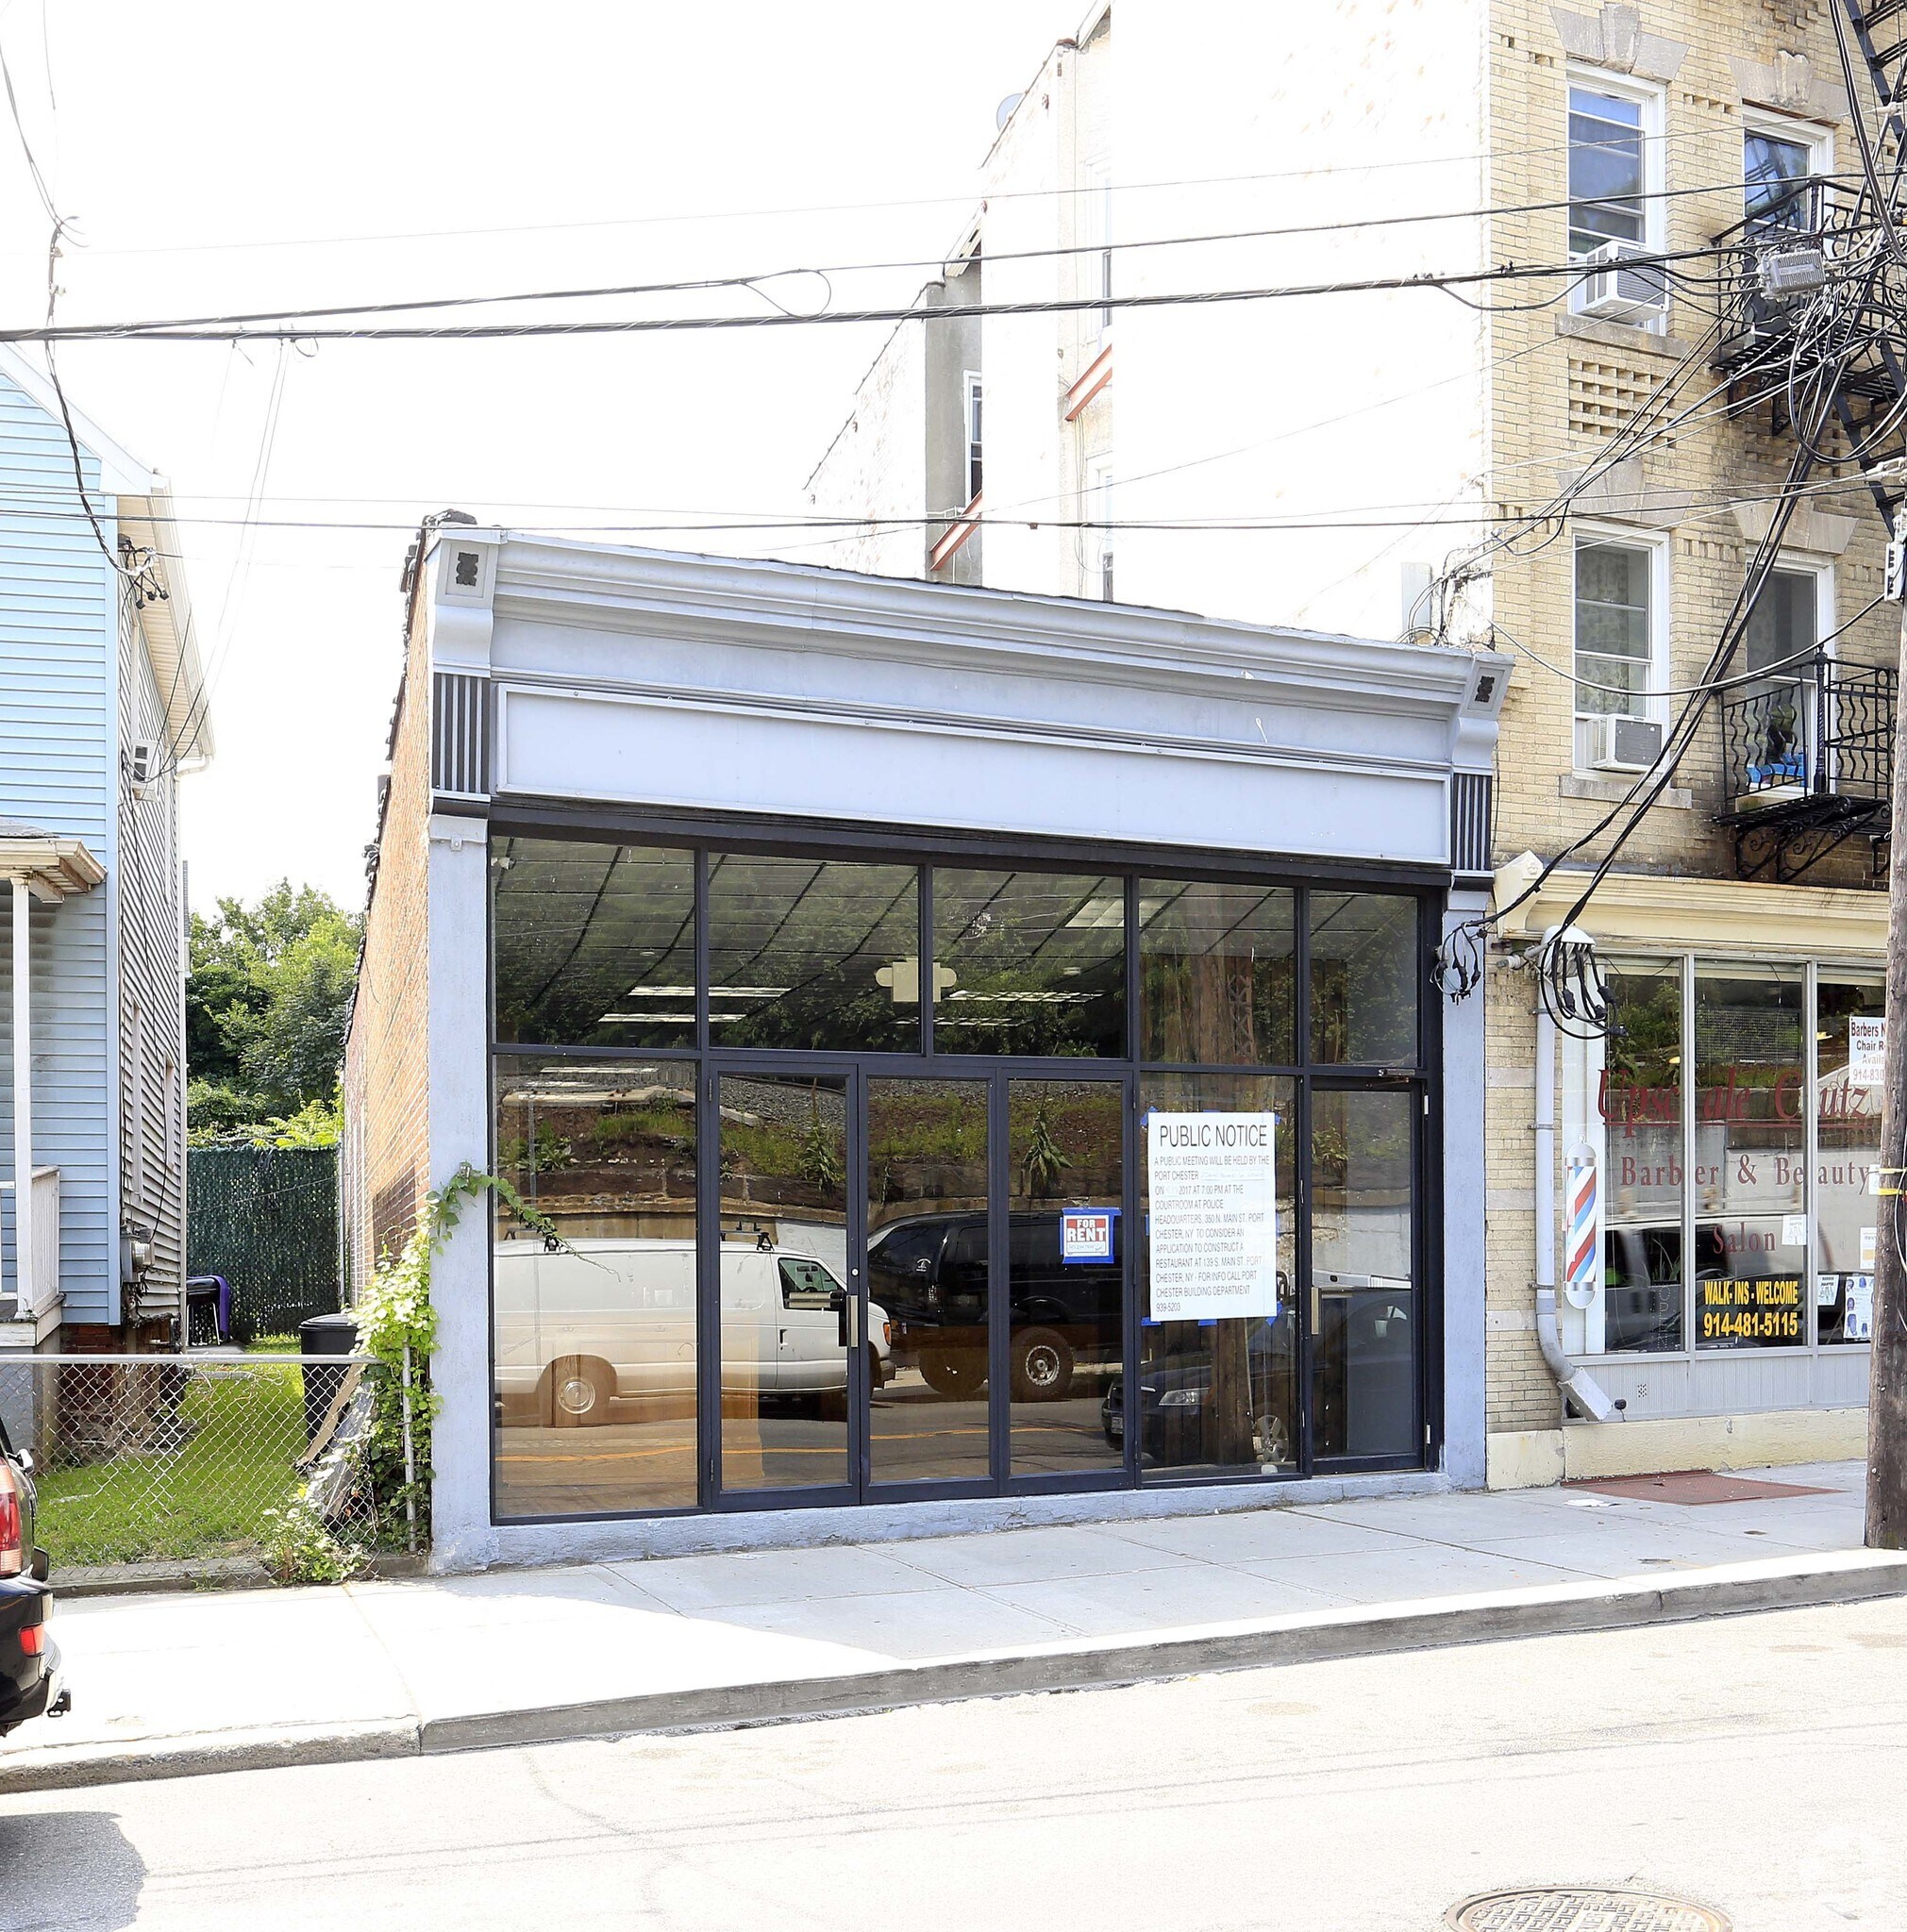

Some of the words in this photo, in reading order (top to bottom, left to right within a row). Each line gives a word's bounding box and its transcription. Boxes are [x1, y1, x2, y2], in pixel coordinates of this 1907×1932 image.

[1851, 1022, 1879, 1037] Barbers
[1857, 1041, 1876, 1051] Chair
[1598, 1066, 1752, 1138] Upscale
[1775, 1069, 1871, 1121] Cutz
[1160, 1124, 1211, 1147] PUBLIC
[1215, 1124, 1267, 1147] NOTICE
[1154, 1157, 1159, 1166] A
[1160, 1157, 1181, 1165] PUBLIC
[1182, 1156, 1209, 1165] MEETING
[1210, 1156, 1223, 1165] WILL
[1224, 1156, 1232, 1165] BE
[1232, 1156, 1247, 1165] HELD
[1248, 1156, 1257, 1165] BY
[1258, 1156, 1269, 1165] THE
[1155, 1171, 1170, 1180] PORT
[1171, 1171, 1199, 1180] CHESTER
[1620, 1155, 1719, 1186] Barber
[1737, 1154, 1757, 1185] &
[1775, 1157, 1870, 1196] Beauty
[1155, 1186, 1164, 1195] ON
[1179, 1185, 1192, 1195] 2017
[1193, 1185, 1200, 1194] AT
[1213, 1185, 1224, 1194] PM
[1224, 1185, 1231, 1194] AT
[1232, 1185, 1244, 1194] THE
[1155, 1200, 1194, 1209] COURTROOM
[1194, 1200, 1201, 1209] AT
[1202, 1199, 1224, 1208] POLICE
[1077, 1219, 1096, 1228] FOR
[1223, 1213, 1238, 1224] MAIN
[1248, 1213, 1264, 1223] PORT
[1067, 1227, 1105, 1241] RENT
[1184, 1229, 1194, 1239] NY
[1196, 1229, 1204, 1239] TO
[1205, 1228, 1235, 1238] CONSIDER
[1236, 1228, 1245, 1238] AN
[1713, 1222, 1776, 1255] Salon
[1156, 1243, 1194, 1254] APPLICATION
[1195, 1243, 1203, 1253] TO
[1203, 1242, 1239, 1253] CONSTRUCT
[1239, 1242, 1244, 1251] A
[1156, 1258, 1193, 1268] RESTAURANT
[1194, 1258, 1202, 1268] AT
[1221, 1257, 1236, 1267] MAIN
[1246, 1256, 1262, 1266] PORT
[1185, 1273, 1194, 1282] NY
[1197, 1272, 1212, 1281] FOR
[1212, 1272, 1226, 1281] INFO
[1227, 1271, 1241, 1280] CALL
[1241, 1271, 1257, 1280] PORT
[1156, 1288, 1183, 1298] CHESTER
[1184, 1287, 1212, 1297] BUILDING
[1213, 1285, 1250, 1295] DEPARTMENT
[1734, 1280, 1749, 1306] INS
[1756, 1280, 1798, 1305] WELCOME
[1703, 1311, 1798, 1338] 914-481-5115
